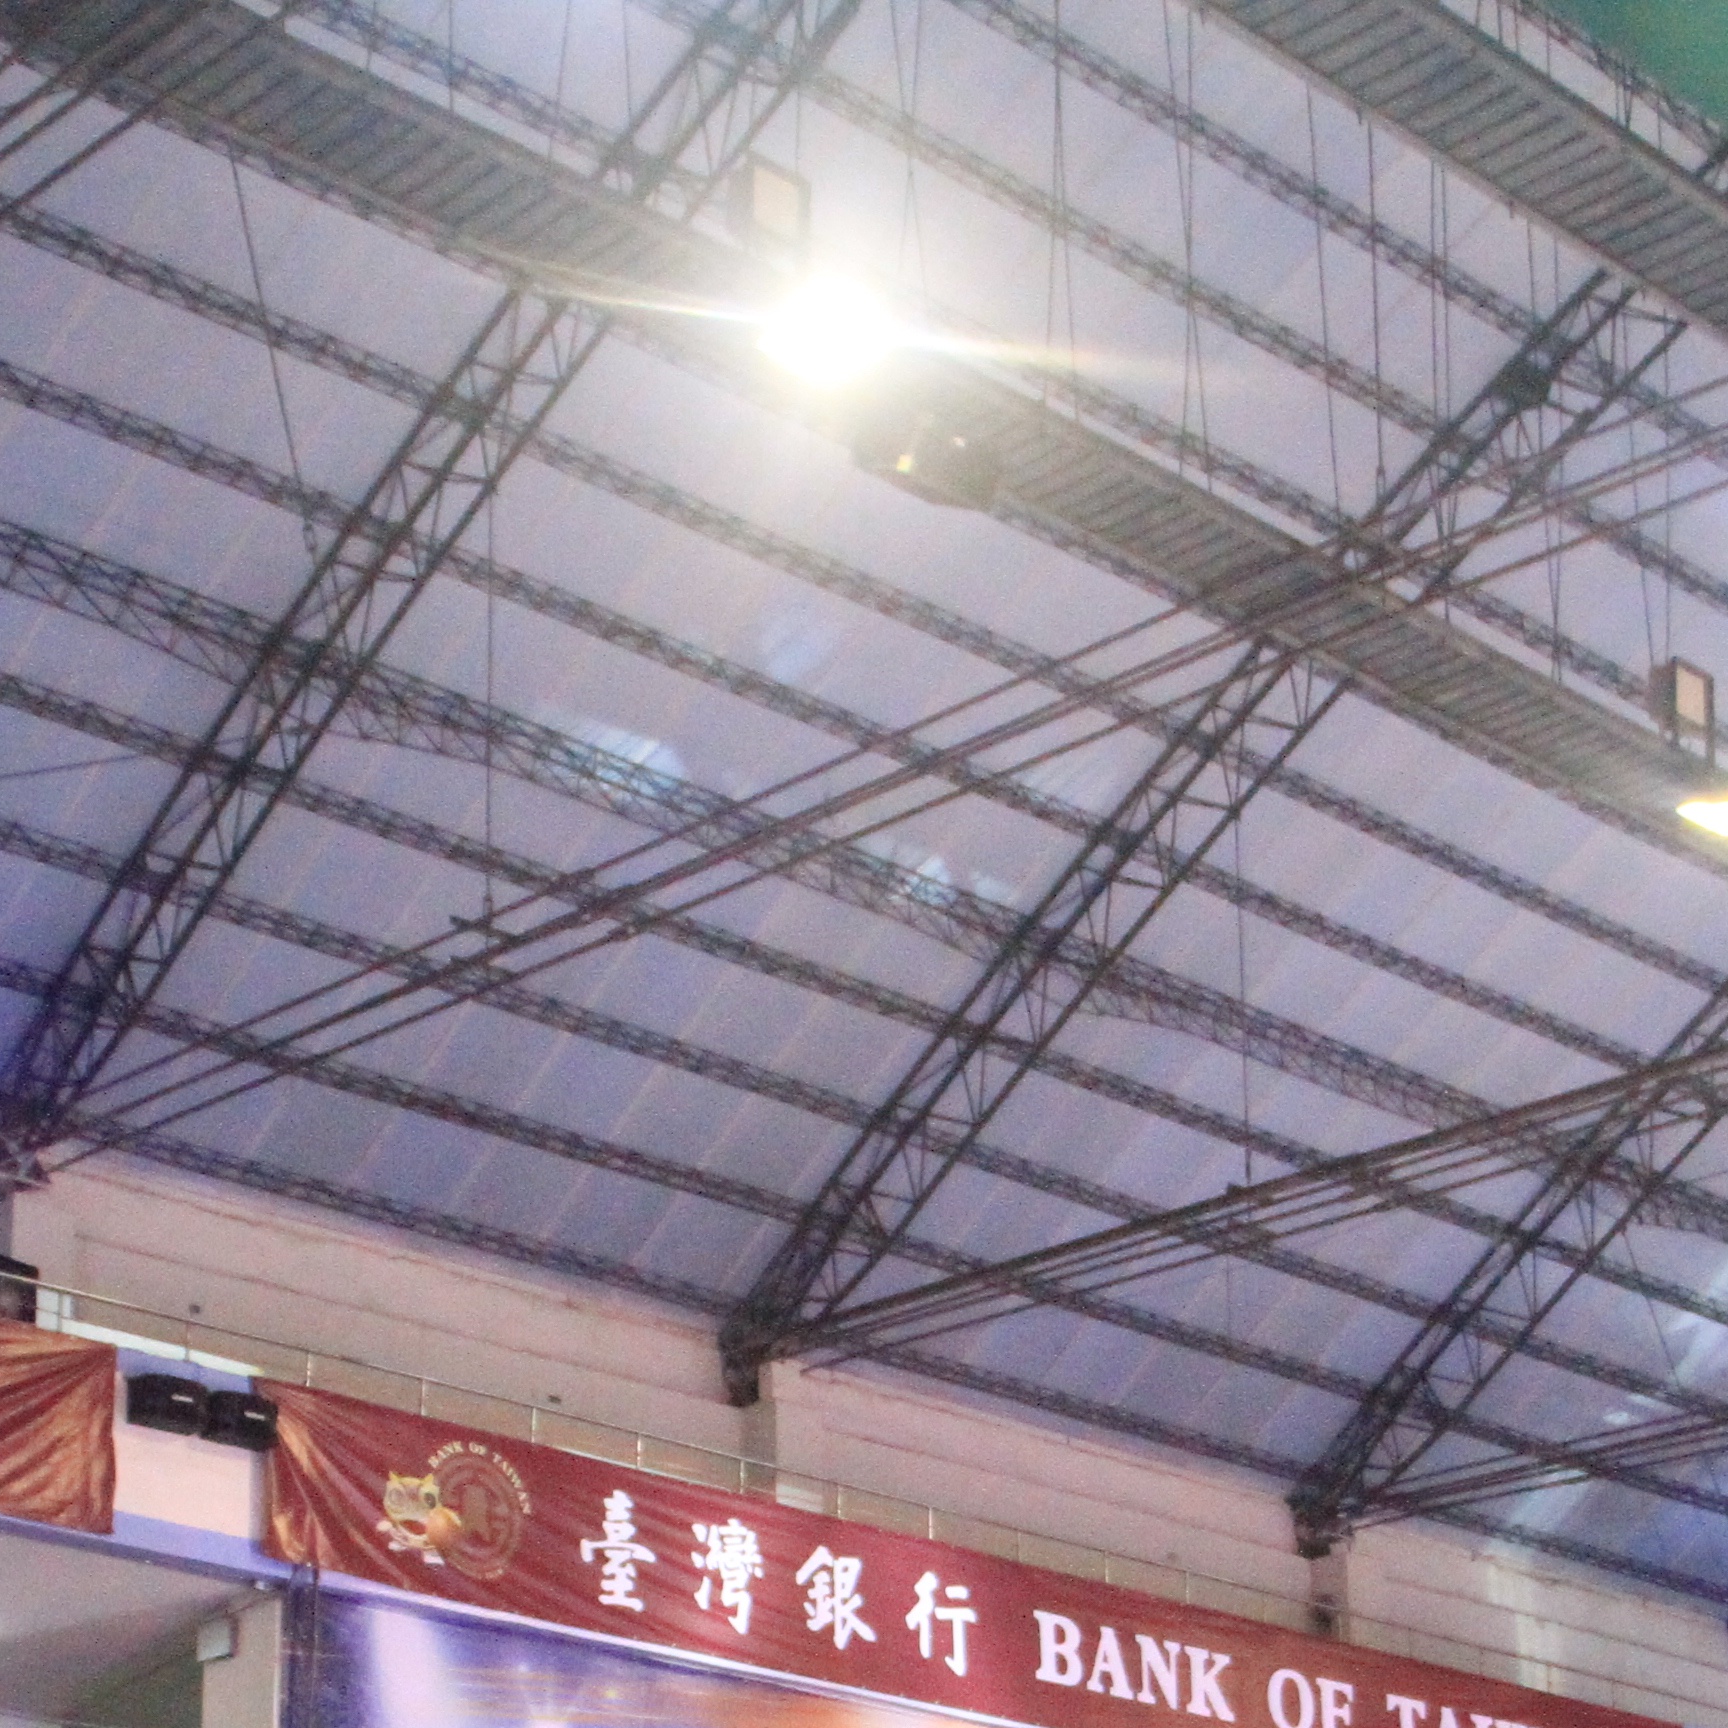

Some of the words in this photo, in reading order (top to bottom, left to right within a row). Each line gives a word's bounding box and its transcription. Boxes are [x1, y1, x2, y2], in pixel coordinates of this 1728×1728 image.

[580, 1490, 977, 1677] 臺灣銀行
[1033, 1610, 1234, 1722] BANK
